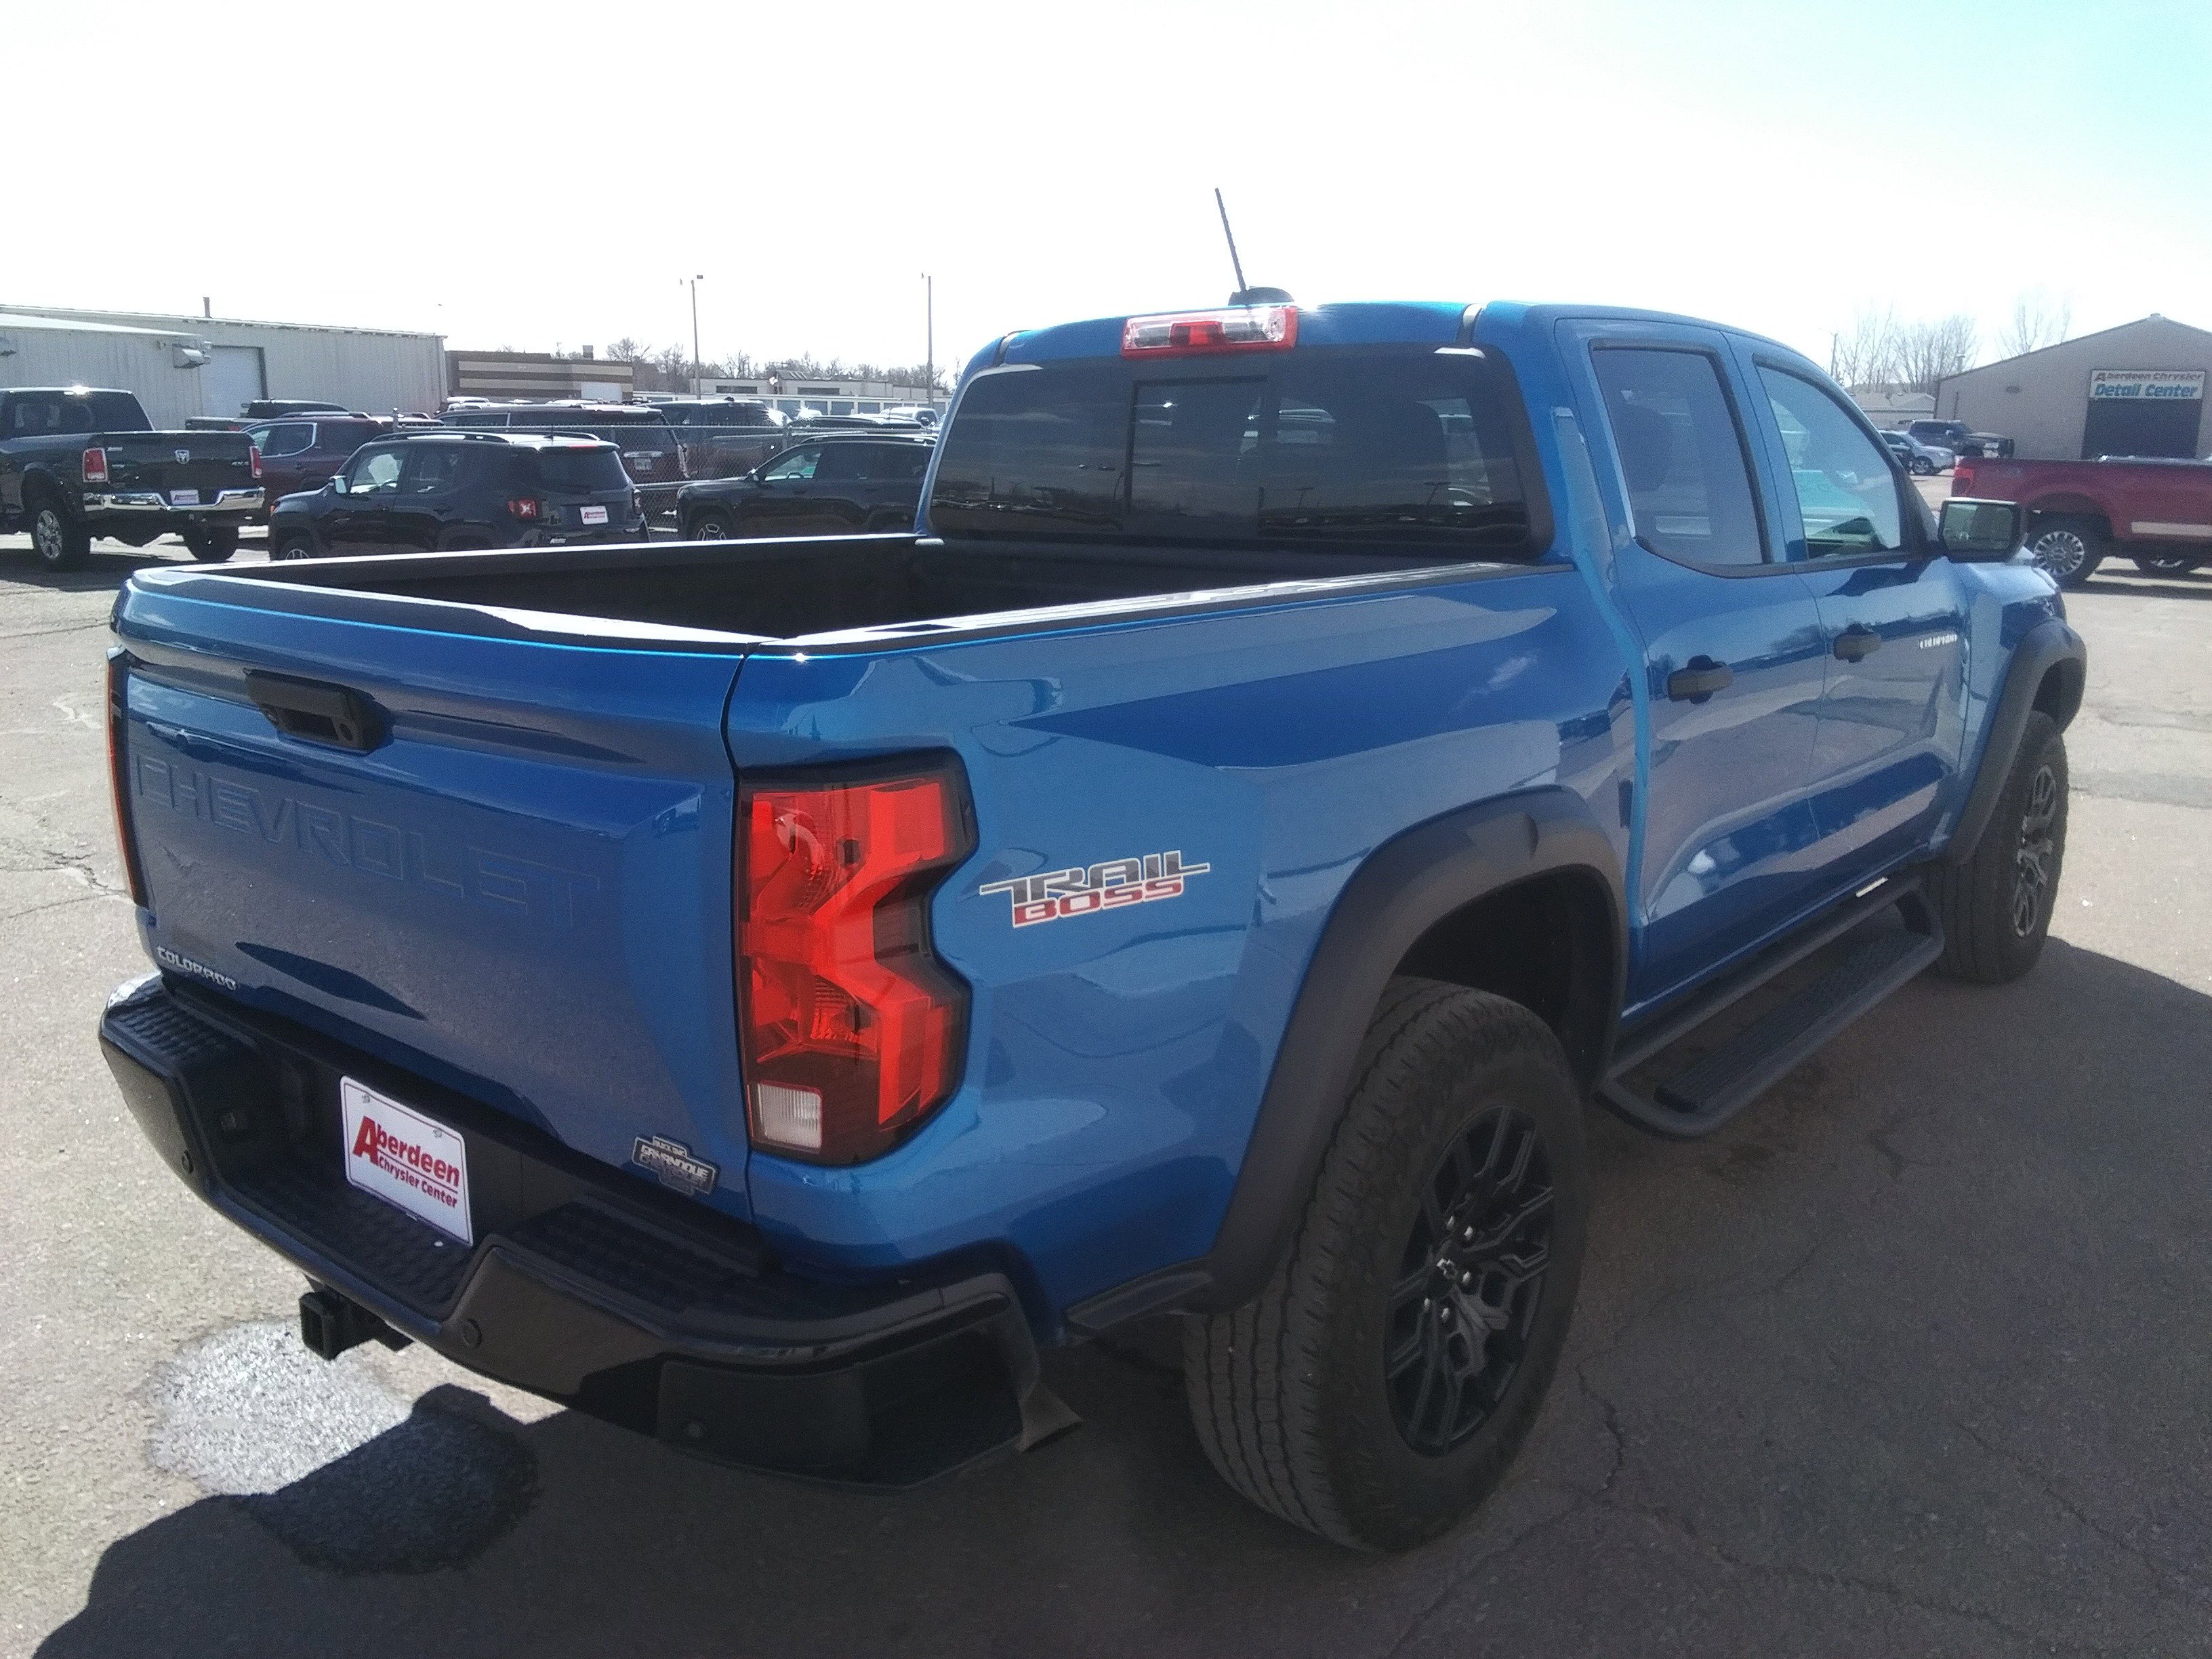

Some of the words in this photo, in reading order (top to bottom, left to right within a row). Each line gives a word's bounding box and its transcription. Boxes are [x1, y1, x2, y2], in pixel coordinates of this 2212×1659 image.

[2095, 383, 2142, 396] Detail
[2144, 384, 2198, 397] Center
[137, 754, 601, 928] CHEVROLET
[979, 850, 1210, 905] TRAIL
[1012, 876, 1184, 928] BOSS
[157, 945, 237, 991] COLORADO
[352, 1115, 460, 1187] Aberdeen
[379, 1155, 420, 1188] Chrysler
[421, 1179, 458, 1208] Center
